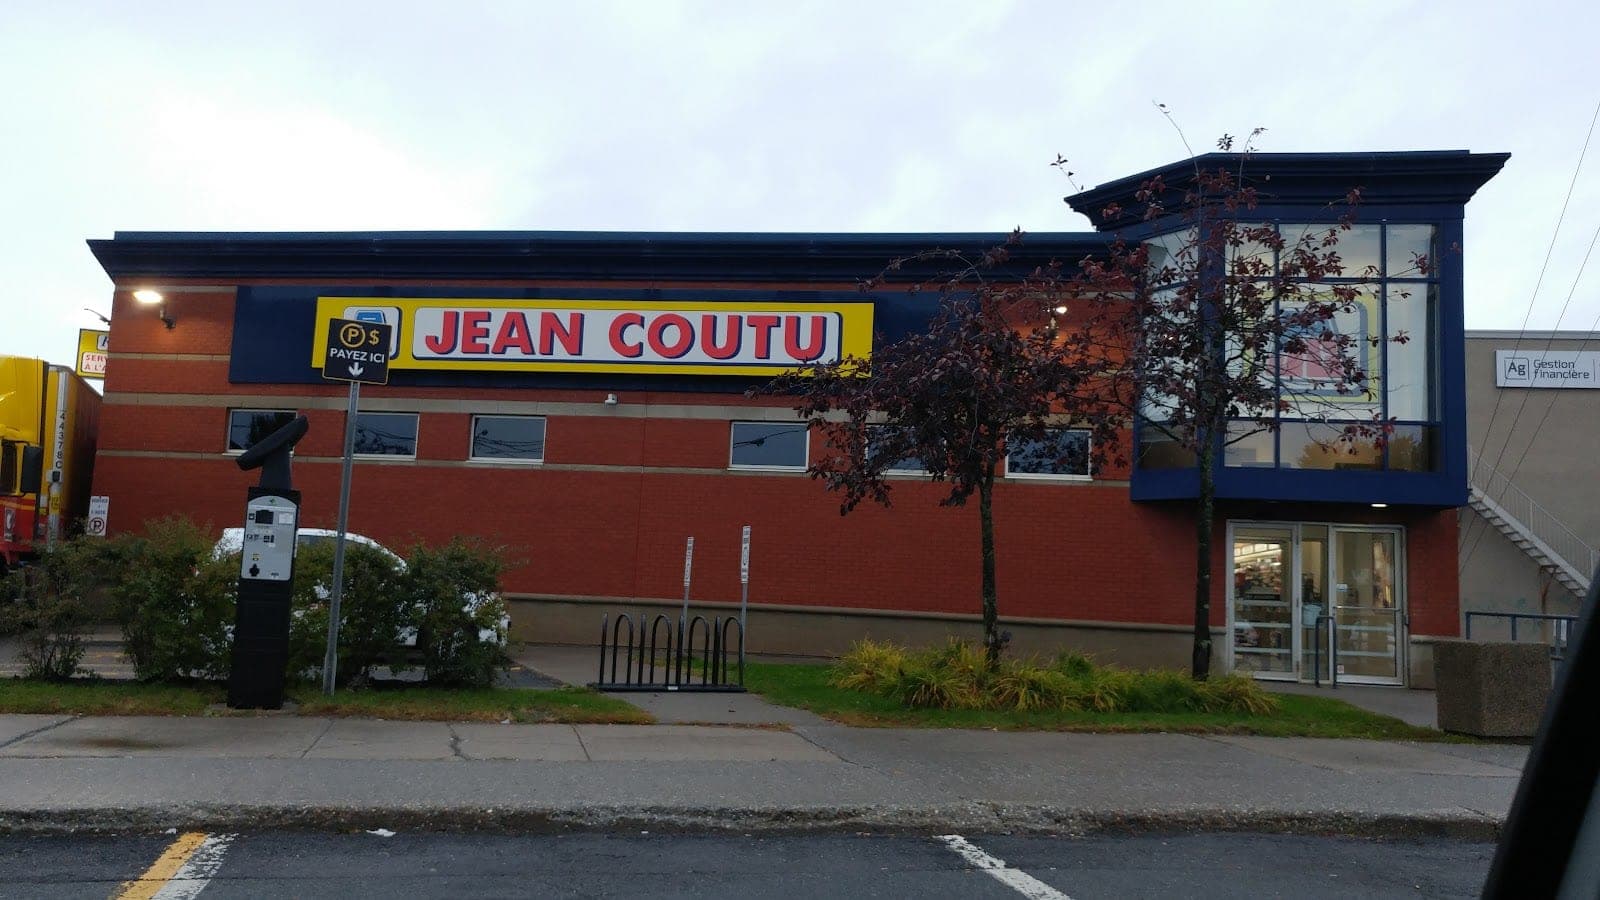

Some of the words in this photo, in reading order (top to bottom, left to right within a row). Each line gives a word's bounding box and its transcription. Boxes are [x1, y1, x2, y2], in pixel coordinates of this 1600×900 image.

[368, 329, 380, 346] $
[425, 310, 585, 356] JEAN
[608, 312, 829, 361] COUTU
[329, 347, 368, 361] PAYEZ
[370, 352, 385, 364] ICI
[1533, 359, 1575, 369] Gestion
[1507, 361, 1526, 376] Ag
